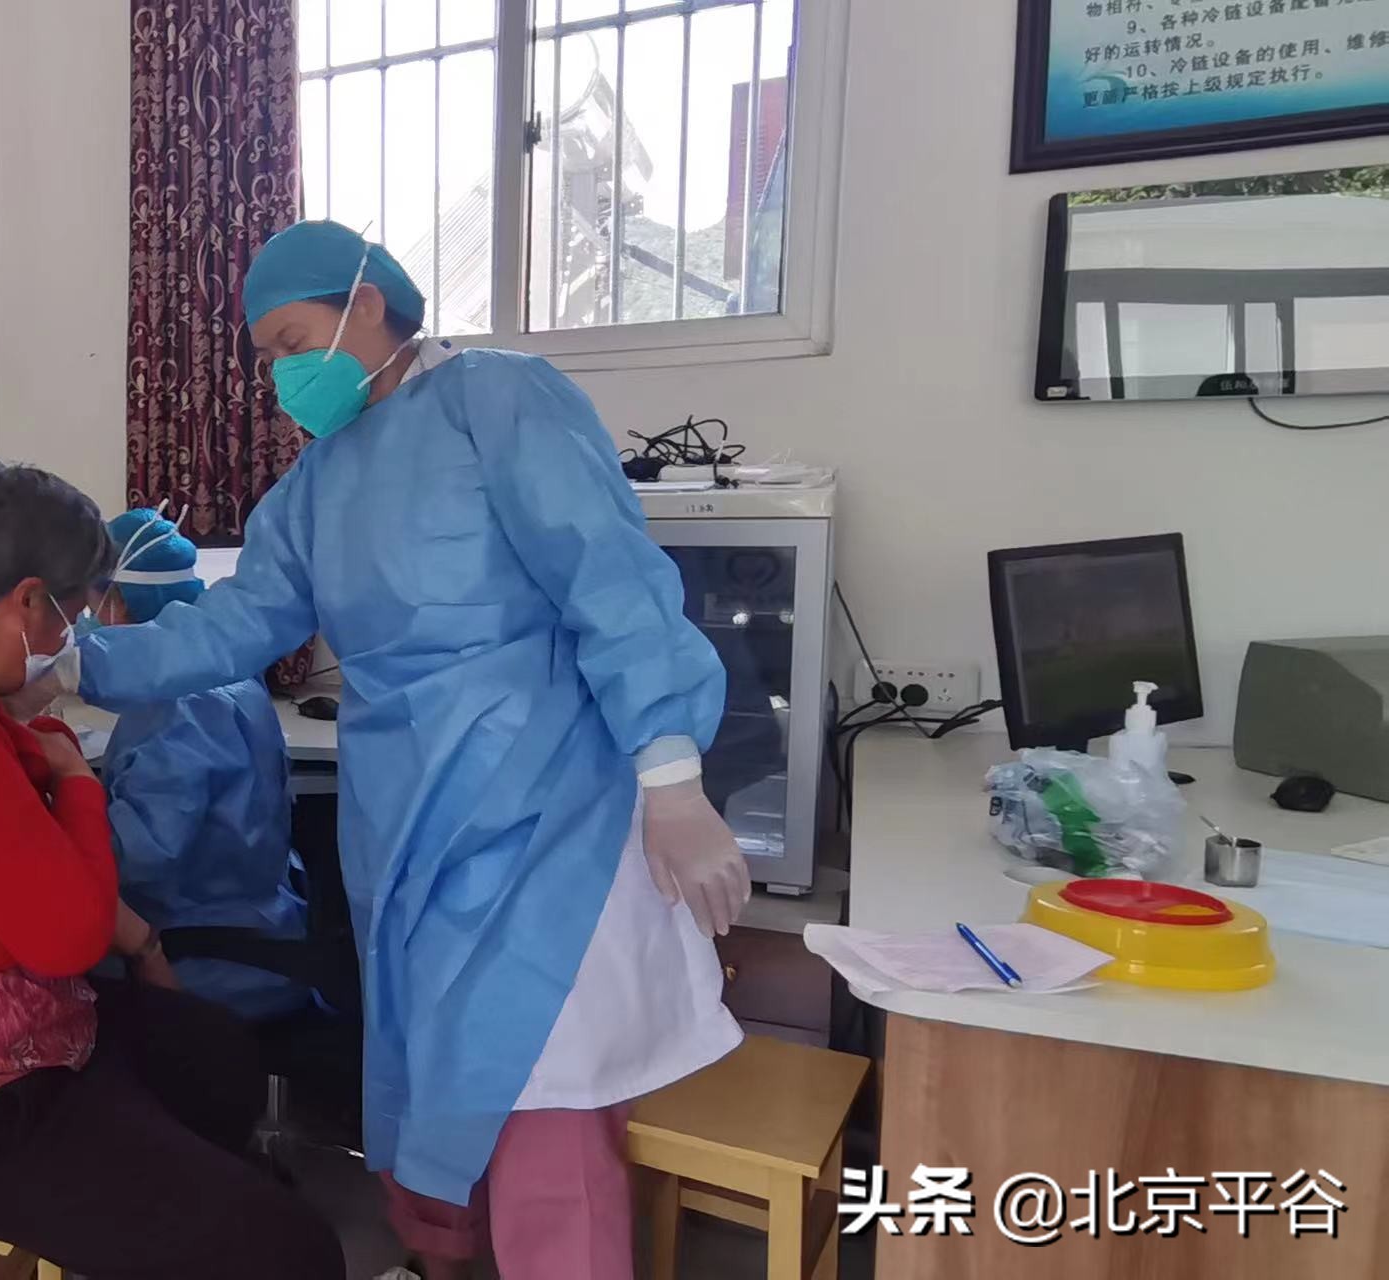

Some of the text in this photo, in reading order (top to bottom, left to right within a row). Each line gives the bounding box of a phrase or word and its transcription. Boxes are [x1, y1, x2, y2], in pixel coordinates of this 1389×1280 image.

[1084, 33, 1215, 64] 好的运转情况。
